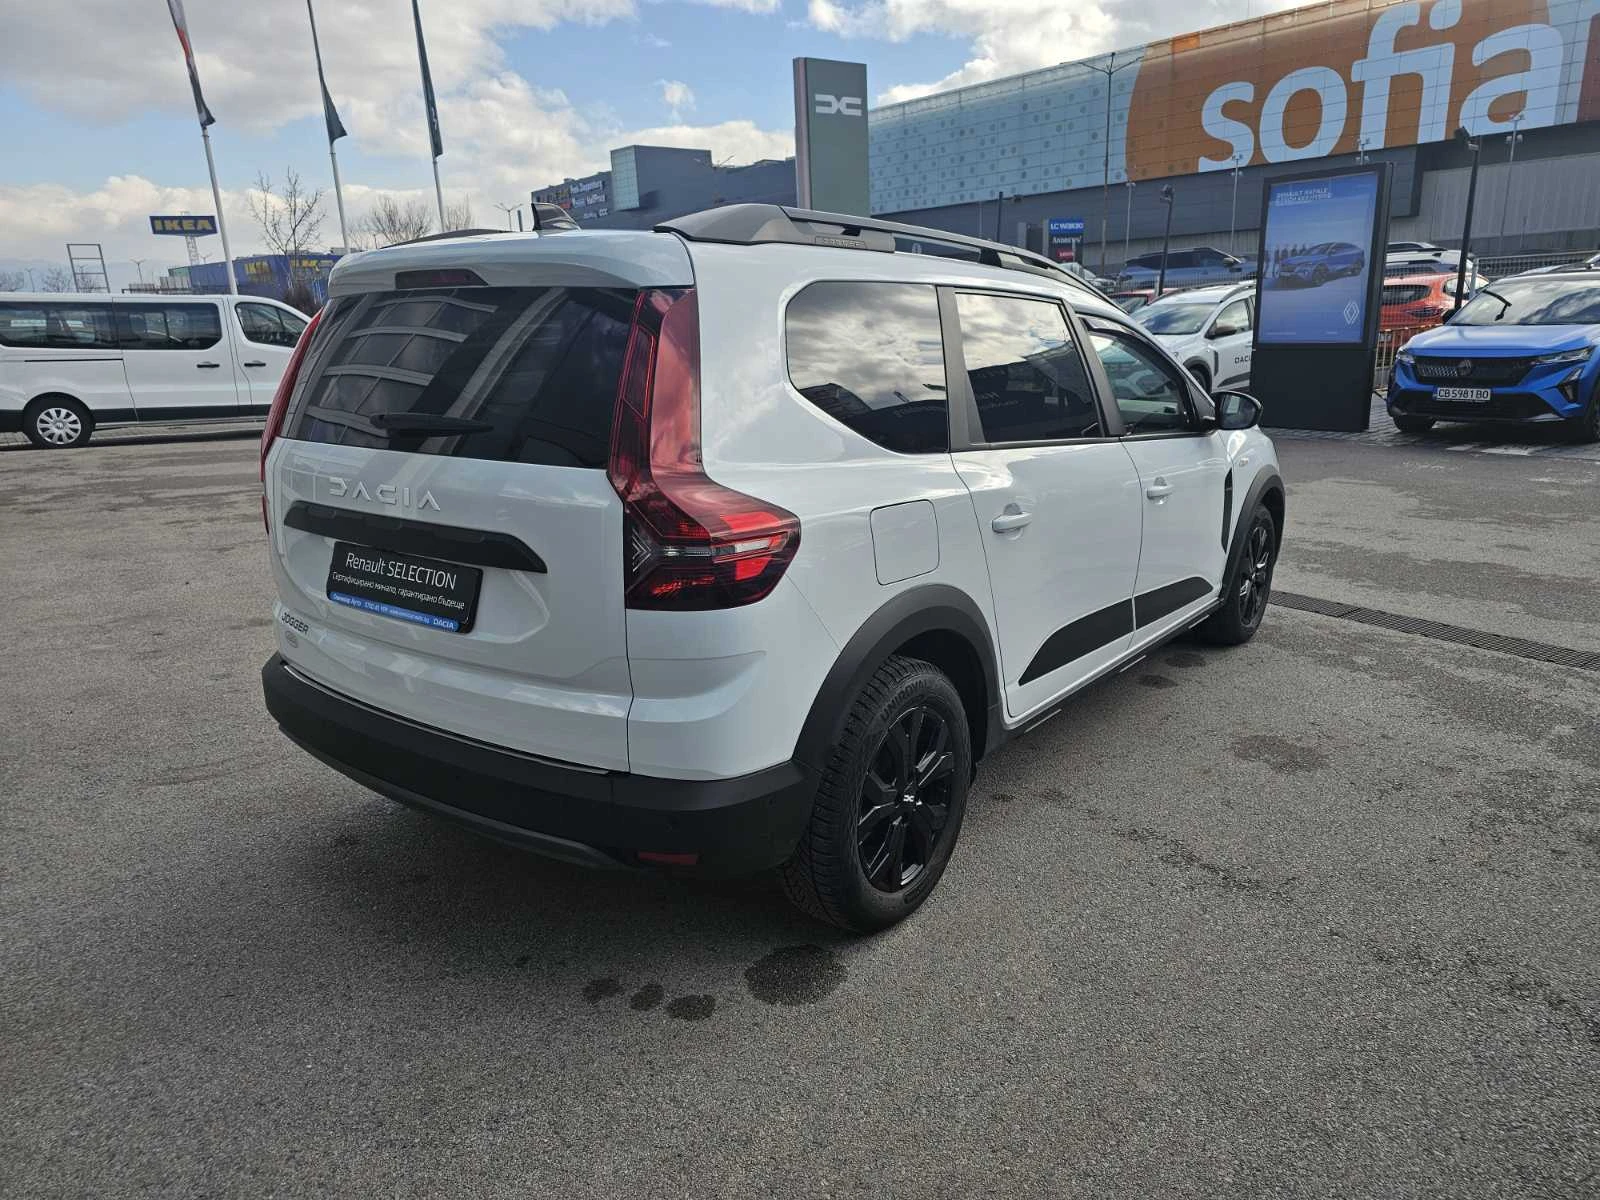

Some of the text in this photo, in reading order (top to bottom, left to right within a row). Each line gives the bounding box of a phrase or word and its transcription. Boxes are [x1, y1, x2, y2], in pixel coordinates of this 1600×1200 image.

[1199, 0, 1563, 172] sofia
[154, 219, 212, 231] IKEA
[1234, 354, 1251, 364] DACI
[329, 476, 441, 511] DACIA
[345, 552, 457, 590] Renault SELECTION
[281, 612, 309, 635] JOGGER
[433, 618, 454, 630] DACIA
